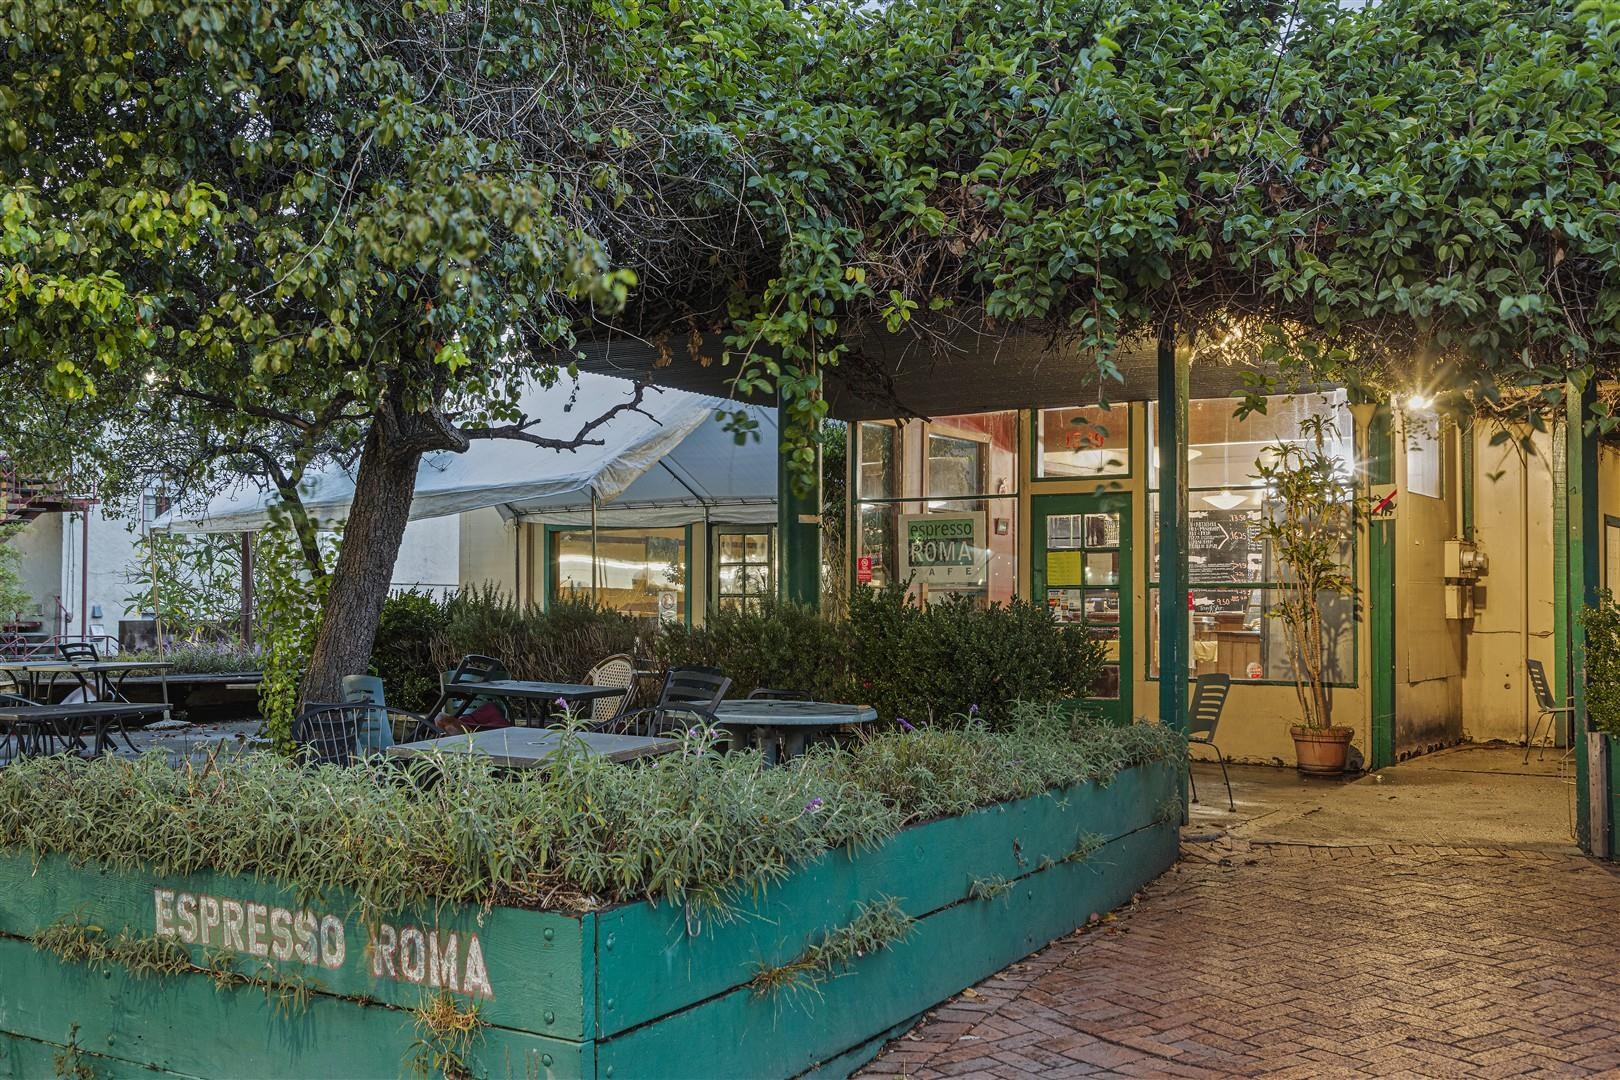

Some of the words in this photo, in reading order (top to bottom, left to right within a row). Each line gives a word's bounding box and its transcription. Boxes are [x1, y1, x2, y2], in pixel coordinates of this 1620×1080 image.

[910, 523, 972, 537] espresso
[911, 541, 972, 562] ROMA
[911, 567, 972, 577] CAFE
[154, 888, 345, 969] ESPRESSO
[372, 923, 494, 1000] ROMA
